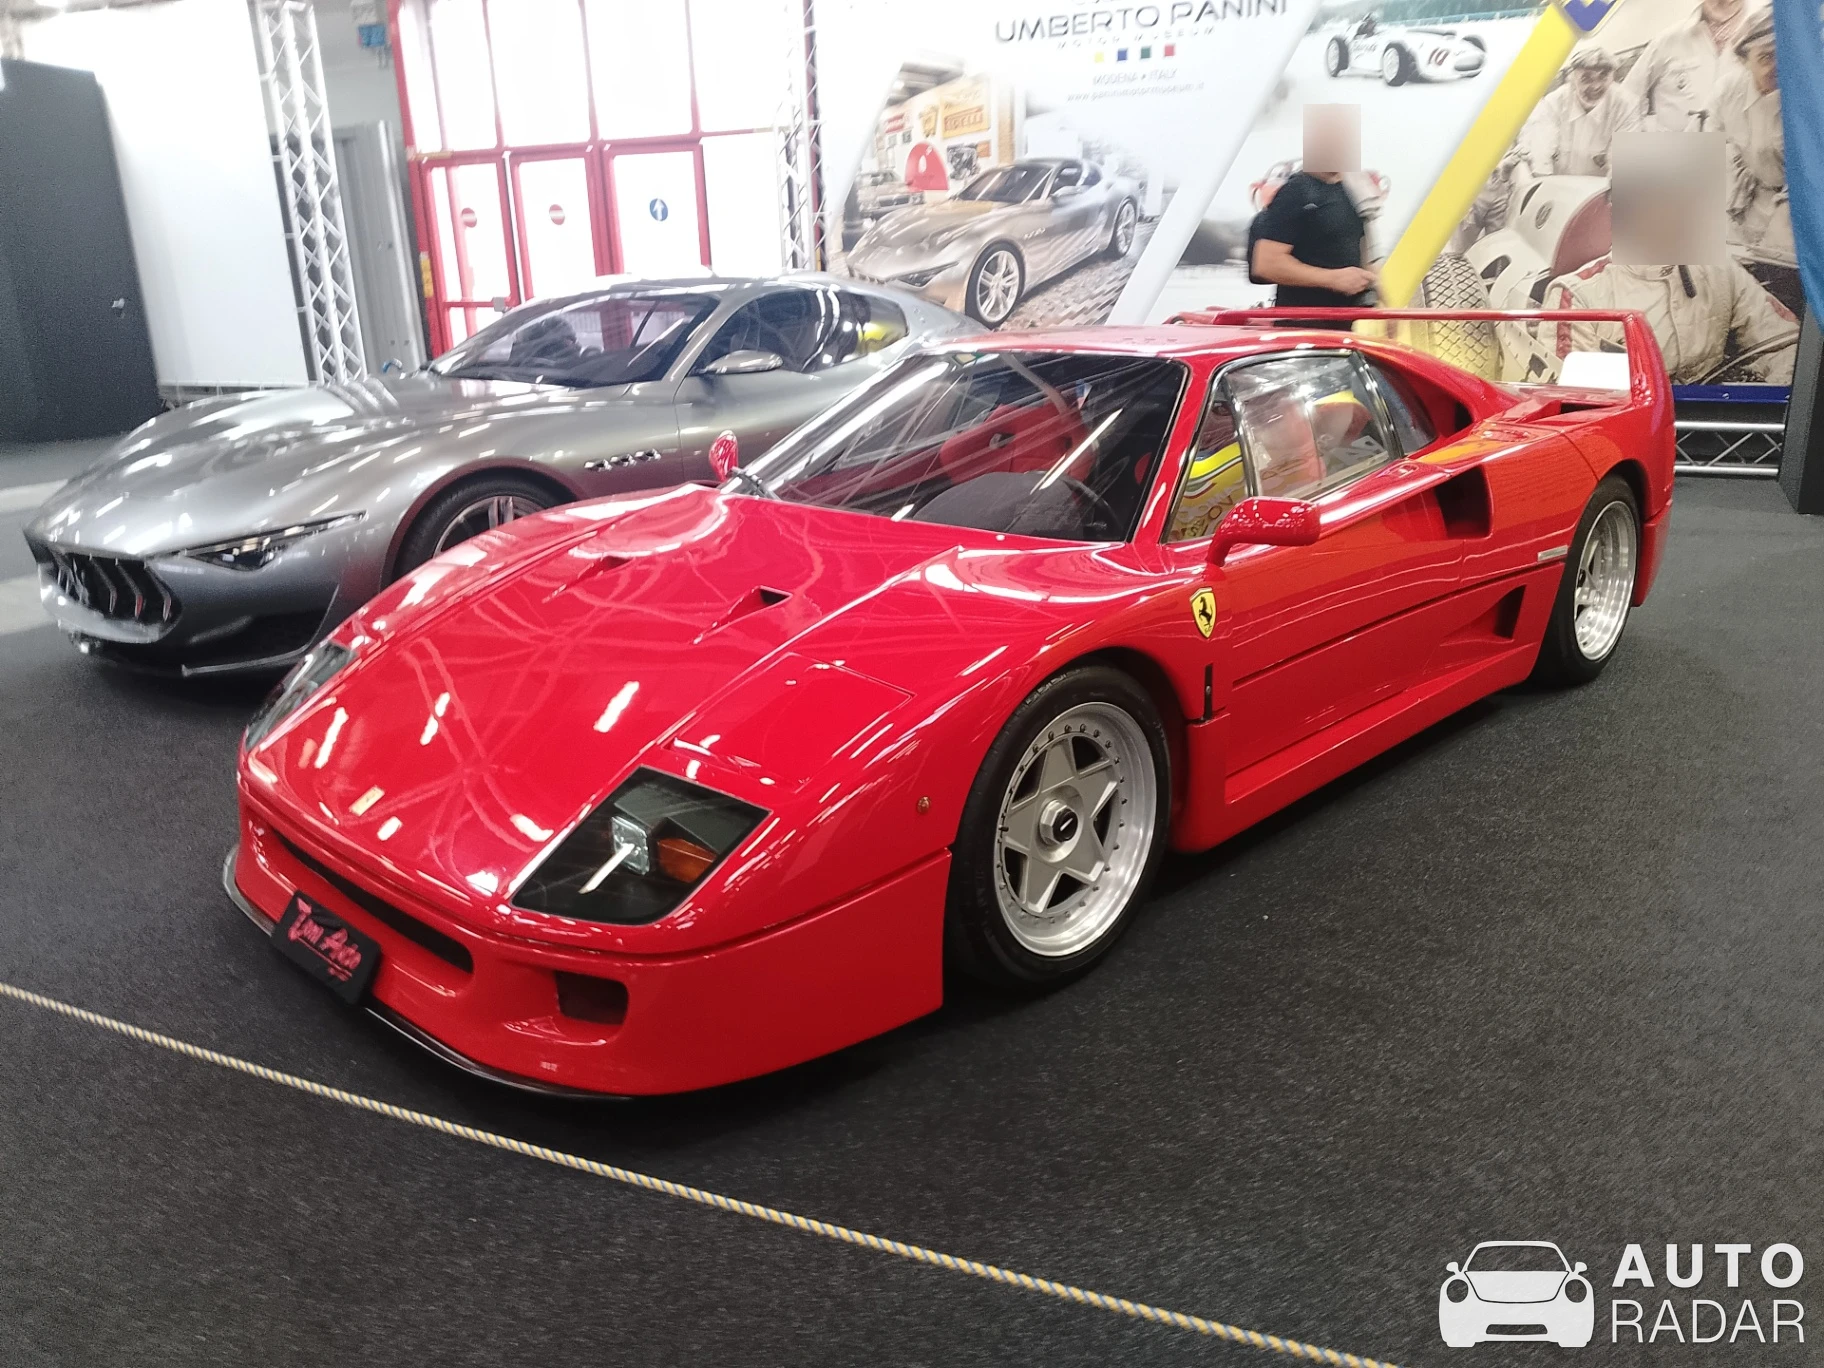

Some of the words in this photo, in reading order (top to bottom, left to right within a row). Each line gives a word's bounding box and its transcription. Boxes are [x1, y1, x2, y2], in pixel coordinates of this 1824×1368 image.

[995, 5, 1160, 43] UMBERTO
[1170, 0, 1288, 26] PANINI
[1133, 26, 1216, 42] MUSEUM
[1428, 47, 1450, 66] 10
[1093, 72, 1138, 85] MODENA
[1149, 68, 1178, 80] ITALY
